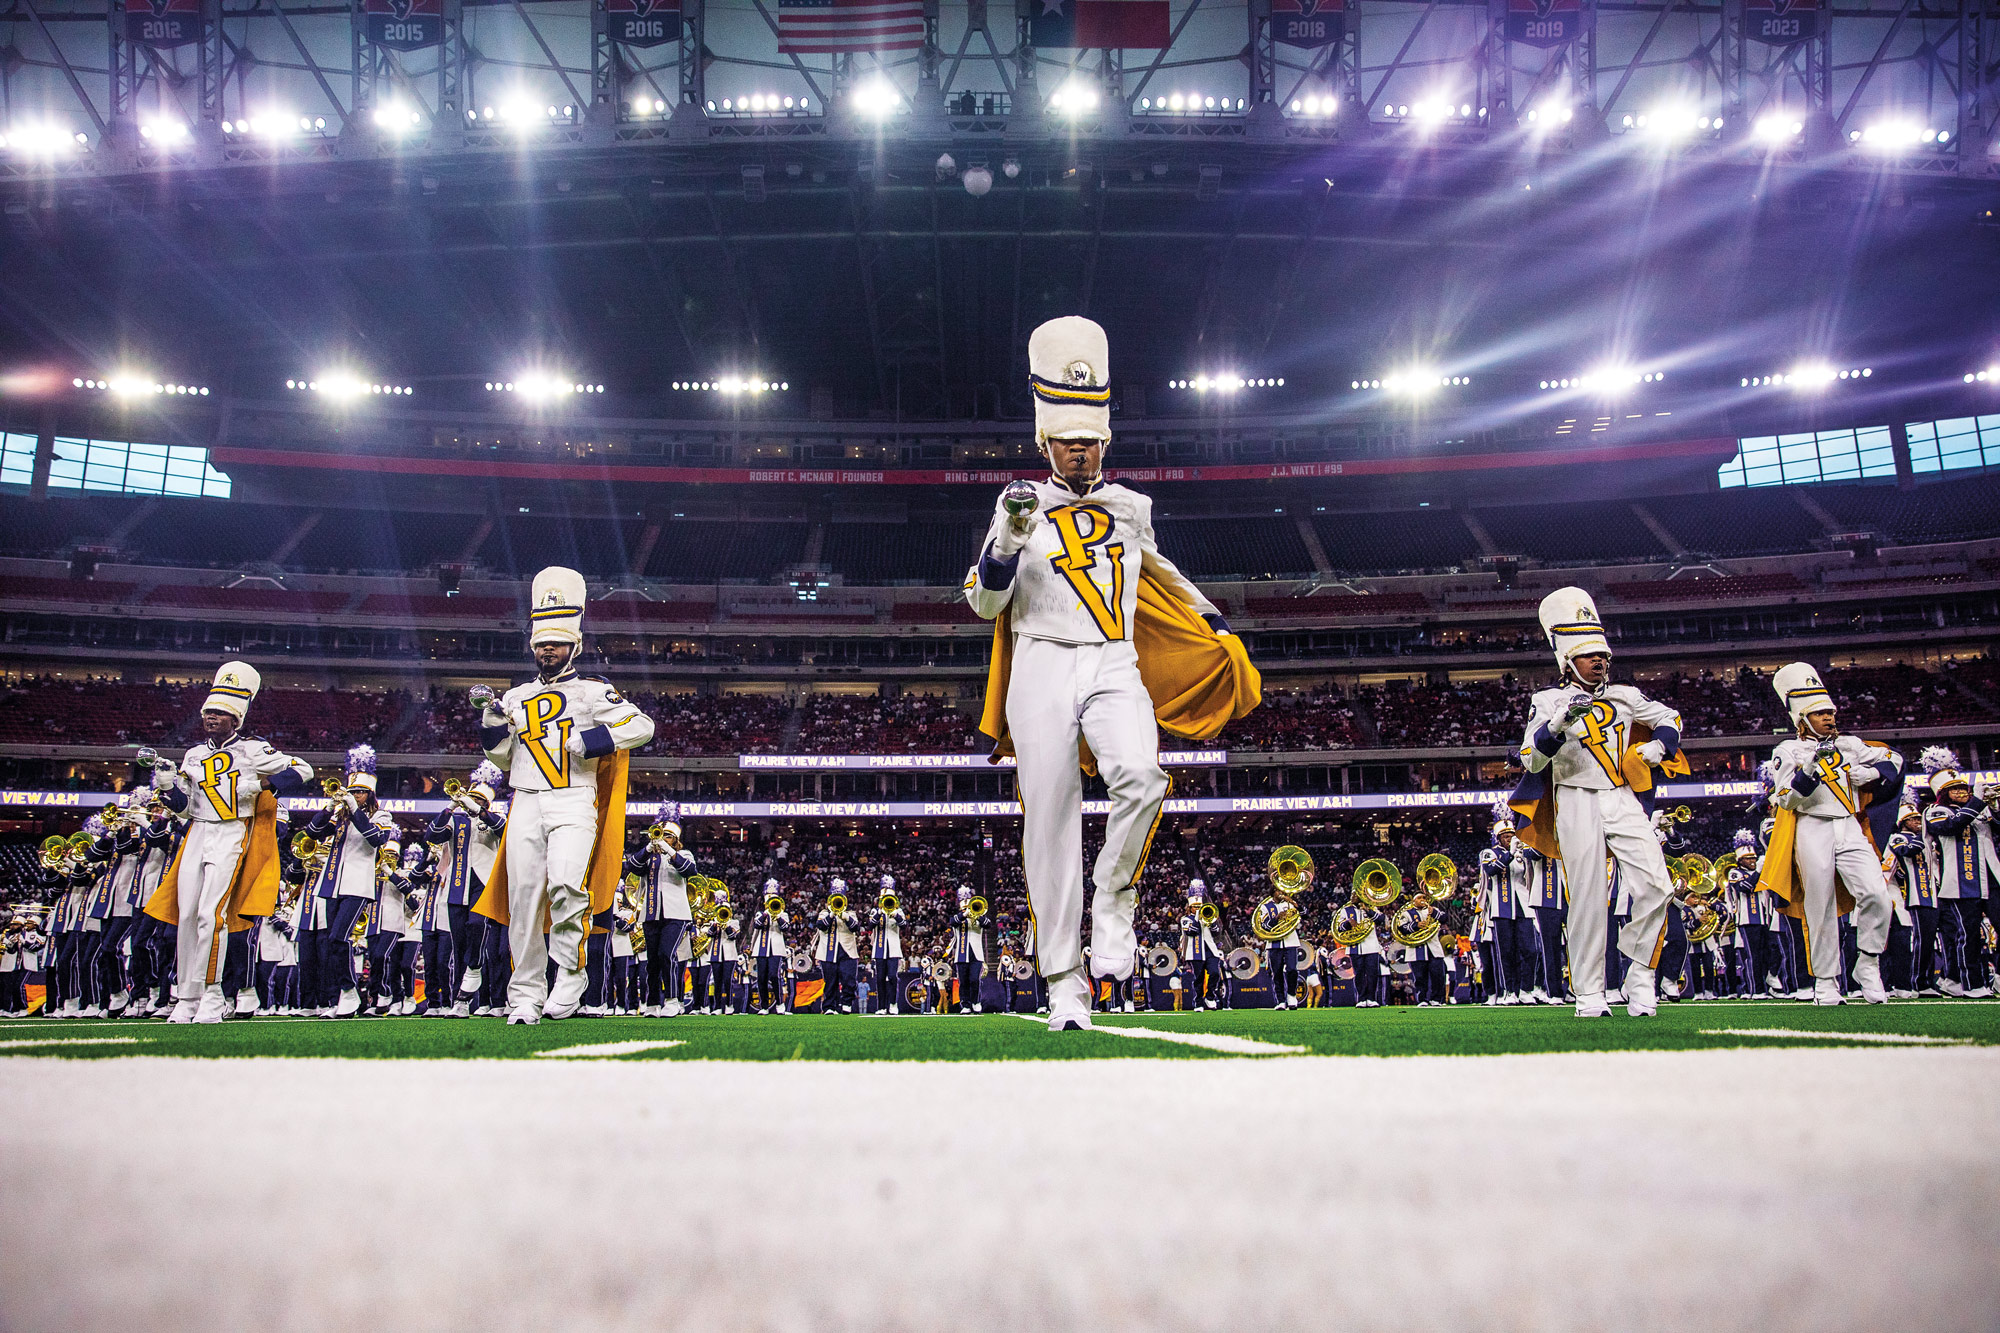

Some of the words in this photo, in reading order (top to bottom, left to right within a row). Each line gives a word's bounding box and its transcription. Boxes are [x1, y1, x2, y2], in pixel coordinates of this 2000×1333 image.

[143, 21, 181, 39] 2012
[384, 23, 424, 41] 2015
[625, 21, 664, 38] 2016
[1287, 21, 1326, 38] 2018
[1525, 21, 1564, 38] 2019
[1762, 19, 1800, 36] 2023
[749, 471, 786, 482] ROBERT
[787, 472, 797, 482] C.
[800, 472, 834, 482] MCNAIR
[842, 473, 884, 482] FOUNDER
[1113, 470, 1157, 481] JOHNSON
[1165, 469, 1184, 479] #80
[1271, 465, 1288, 476] J.J.
[1291, 465, 1315, 476] WATT
[1324, 464, 1343, 474] #99
[945, 472, 968, 482] RING
[980, 473, 1013, 482] HONOR
[744, 756, 786, 766] PRAIRIE
[787, 756, 818, 766] VIEW
[820, 756, 846, 766] A&M
[870, 756, 911, 766] PRAIRIE
[912, 756, 943, 766] VIEW
[944, 756, 970, 766] A&M
[1166, 753, 1194, 763] VIEW
[1196, 752, 1222, 762] A&M
[1974, 772, 2000, 784] A&
[1704, 783, 1760, 796] PRAIRIE
[2, 792, 43, 804] VIEW
[44, 793, 80, 805] A&M
[1232, 798, 1284, 810] PRAIRIE
[1286, 797, 1320, 809] VIEW
[1322, 796, 1352, 808] A&M
[1387, 793, 1439, 806] PRAIRIE
[1441, 792, 1477, 804] VIEW
[1478, 791, 1509, 803] A&M
[384, 800, 416, 811] A&M
[704, 804, 735, 815] A&M
[770, 804, 821, 815] PRAIRIE
[823, 804, 858, 815] VIEW
[859, 804, 890, 815] A&M
[924, 803, 976, 815] PRAIRIE
[978, 803, 1014, 814] VIEW
[1168, 800, 1198, 811] A&M
[454, 823, 467, 887] PANTHERS
[1962, 827, 1974, 880] NTHERS
[1545, 857, 1553, 898] NTHERS
[1915, 853, 1928, 898] NTHERS
[304, 872, 316, 914] ANTHERS
